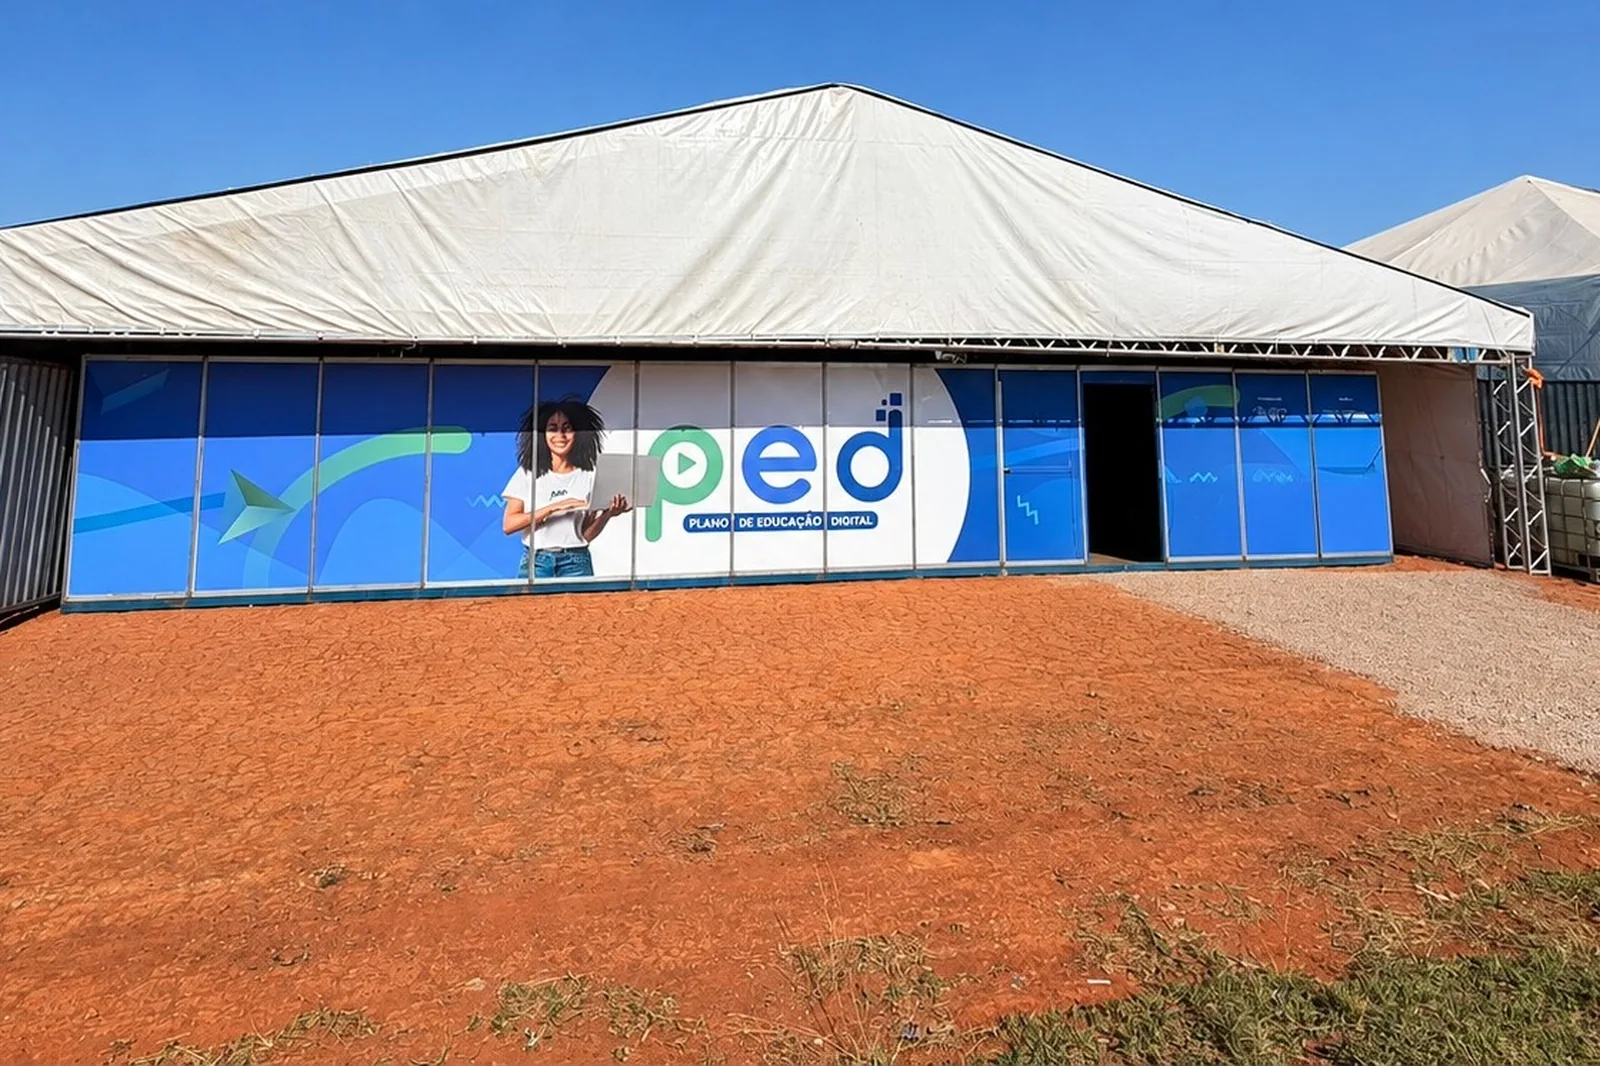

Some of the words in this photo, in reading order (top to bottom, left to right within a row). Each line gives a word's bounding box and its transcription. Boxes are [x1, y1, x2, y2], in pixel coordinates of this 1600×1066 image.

[645, 405, 904, 543] ped
[688, 517, 730, 529] PLANO
[739, 517, 753, 528] DE
[757, 513, 822, 529] EDUCAÇÃO
[831, 515, 873, 527] DIGITAL
